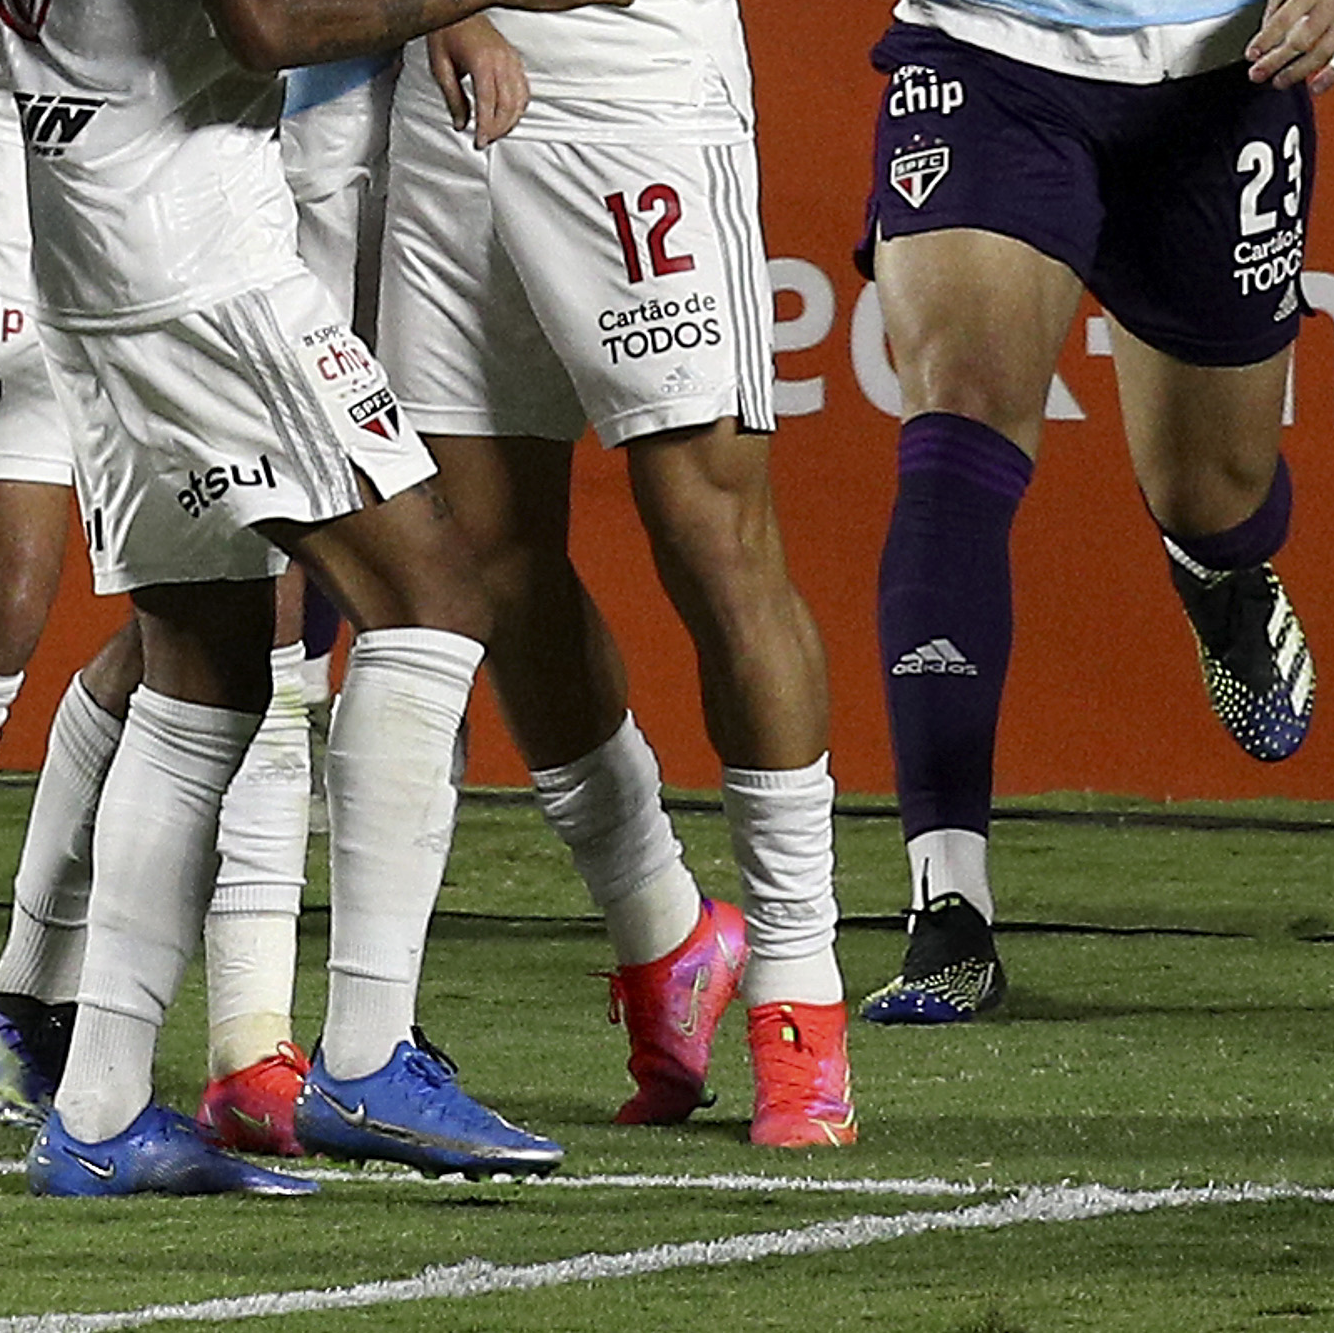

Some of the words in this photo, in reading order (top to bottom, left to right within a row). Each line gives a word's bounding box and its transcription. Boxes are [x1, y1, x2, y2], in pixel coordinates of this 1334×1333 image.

[889, 75, 964, 117] chip
[1236, 125, 1303, 236] 23
[604, 183, 696, 285] 12
[598, 299, 681, 331] Cartão
[685, 293, 716, 314] de
[602, 318, 721, 365] TODOS
[891, 657, 978, 676] adidas
